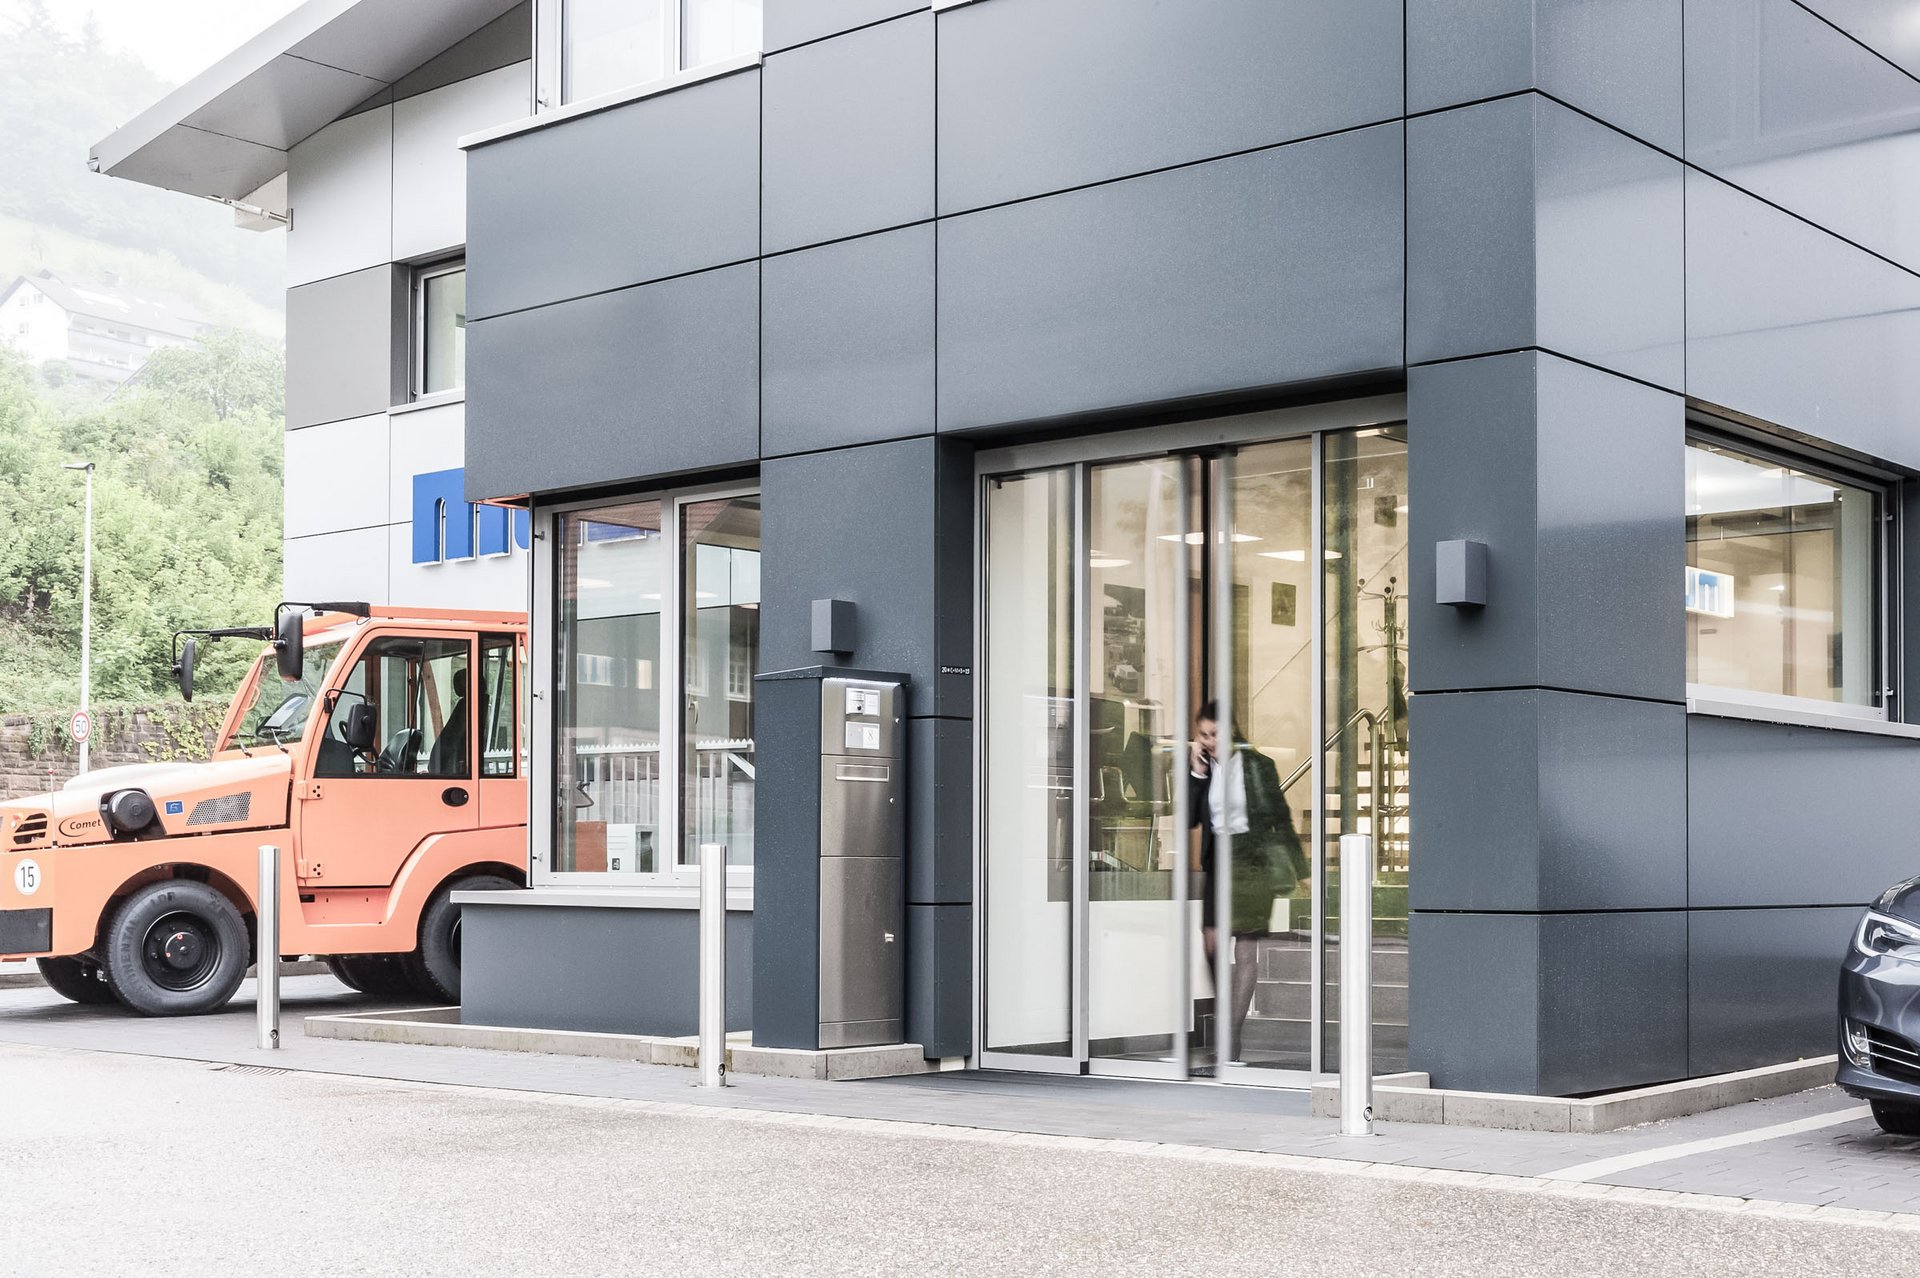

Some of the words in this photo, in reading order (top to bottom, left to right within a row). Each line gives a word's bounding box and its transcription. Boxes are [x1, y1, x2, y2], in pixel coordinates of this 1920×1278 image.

[75, 720, 87, 734] 50
[69, 818, 101, 831] Comet
[20, 866, 35, 888] 15
